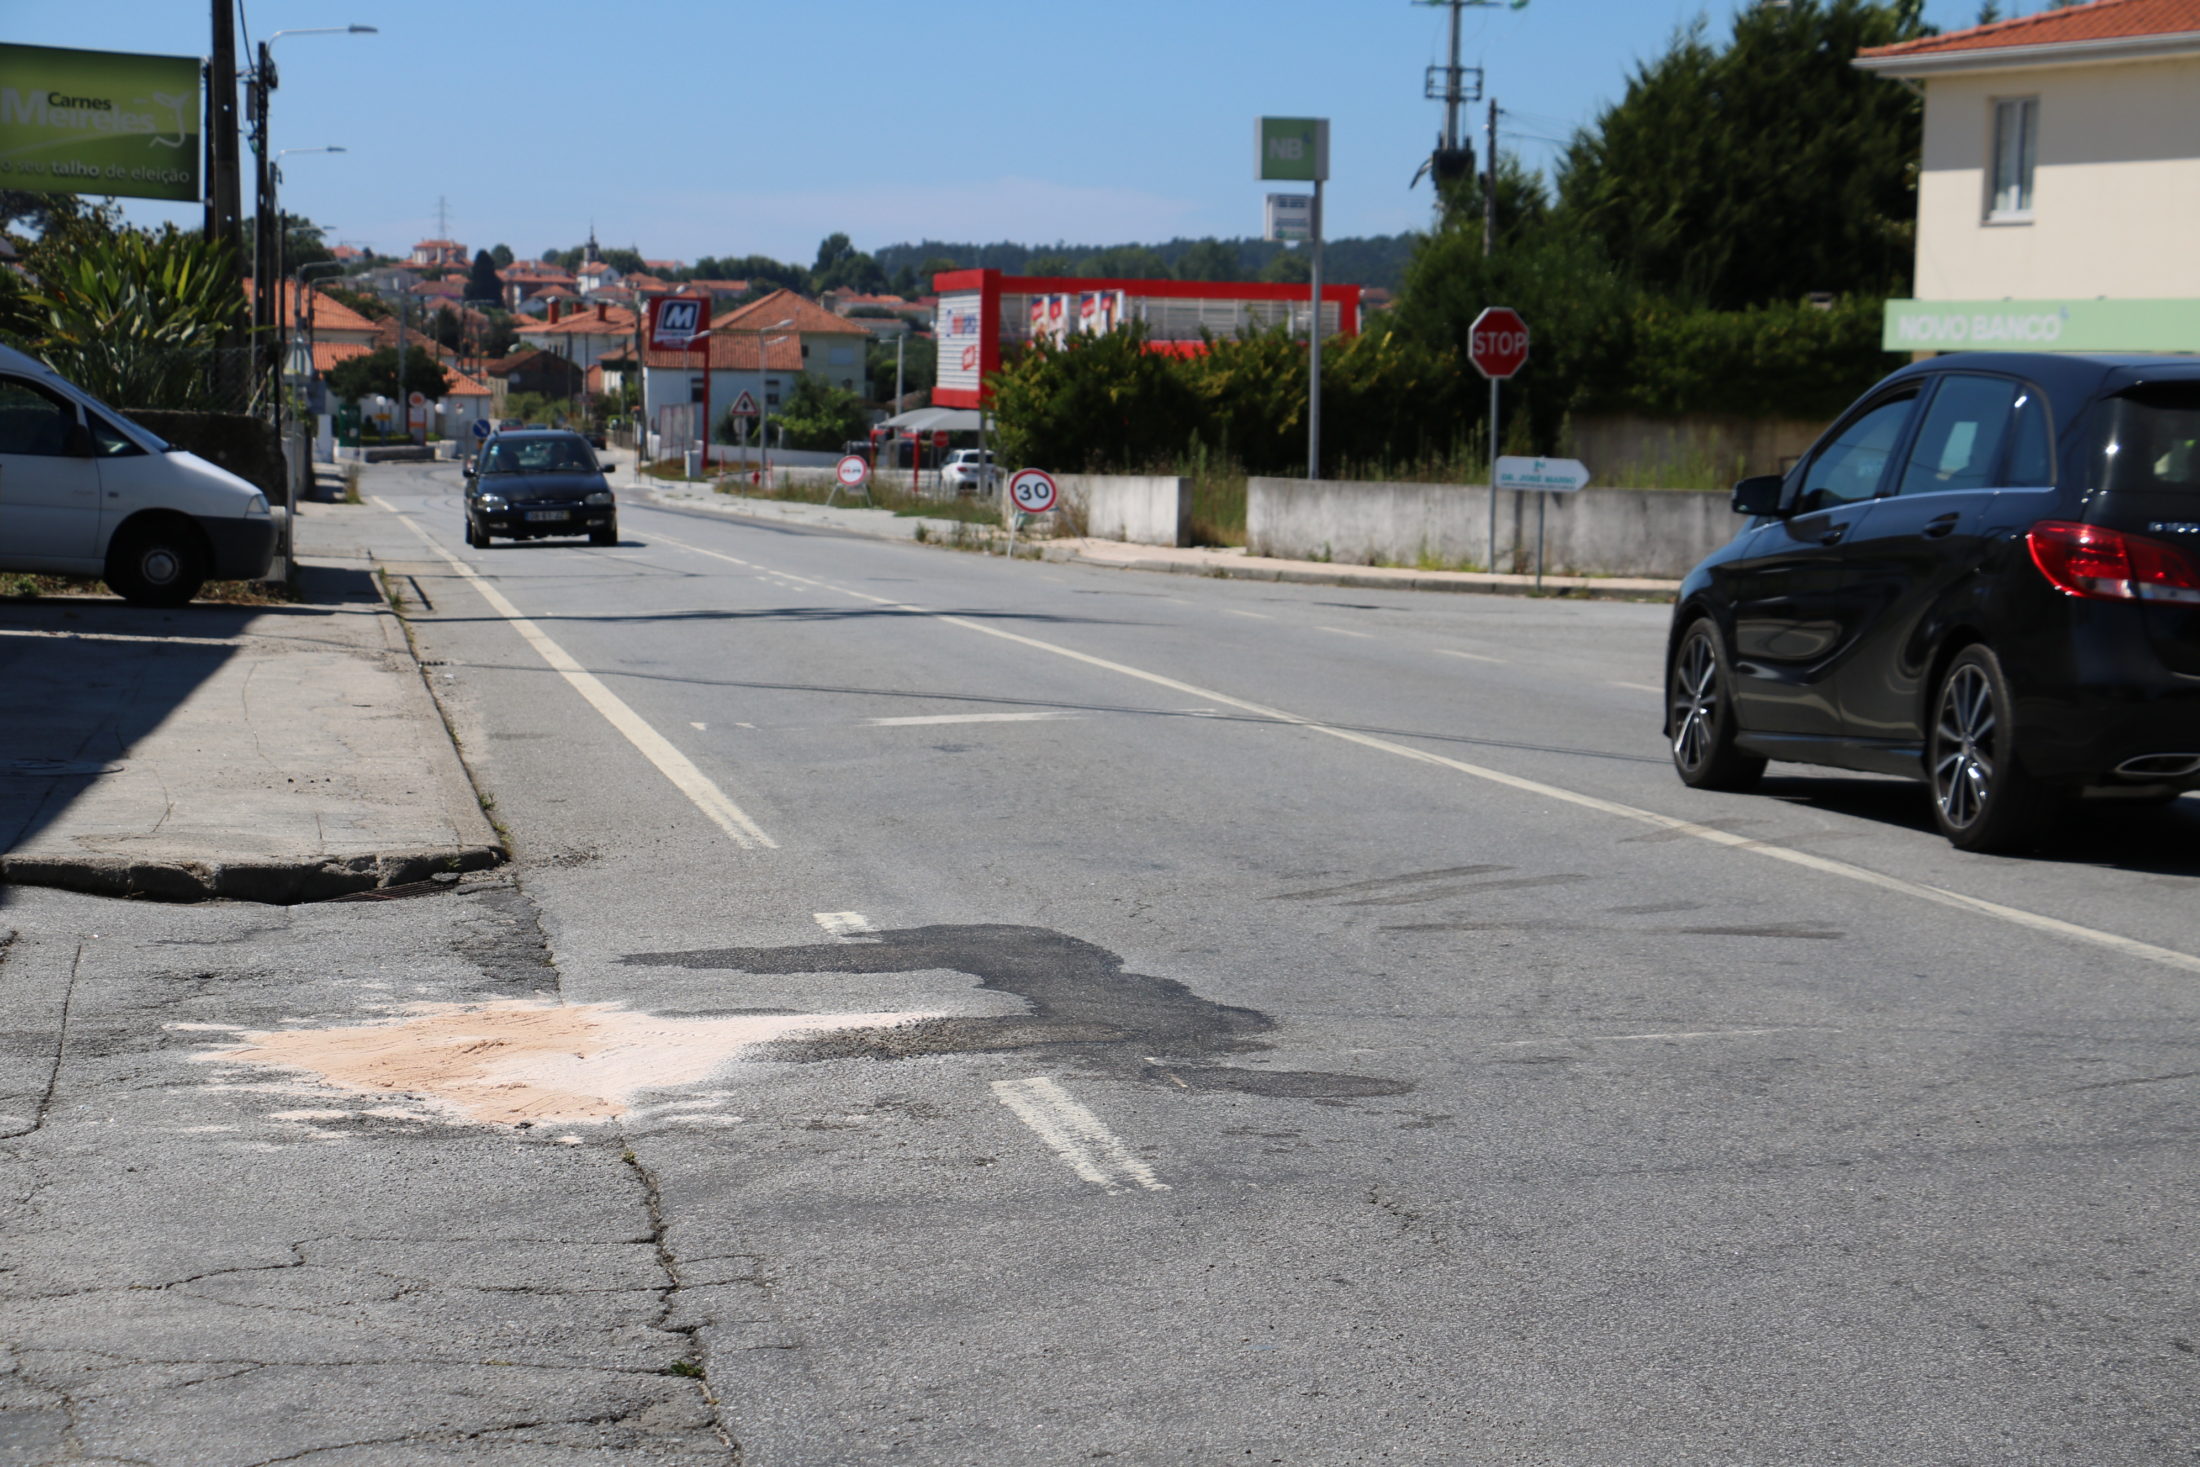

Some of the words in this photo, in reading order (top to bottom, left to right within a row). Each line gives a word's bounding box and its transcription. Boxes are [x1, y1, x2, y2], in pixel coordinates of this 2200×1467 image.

[1, 88, 156, 133] Meireles
[48, 91, 112, 110] Carnes
[51, 160, 100, 178] talho
[104, 163, 126, 178] de
[131, 165, 190, 184] eleição
[1898, 314, 1968, 341] NOVO
[1971, 314, 2061, 341] BANCO
[1472, 331, 1528, 356] STOP
[1017, 482, 1049, 501] 30
